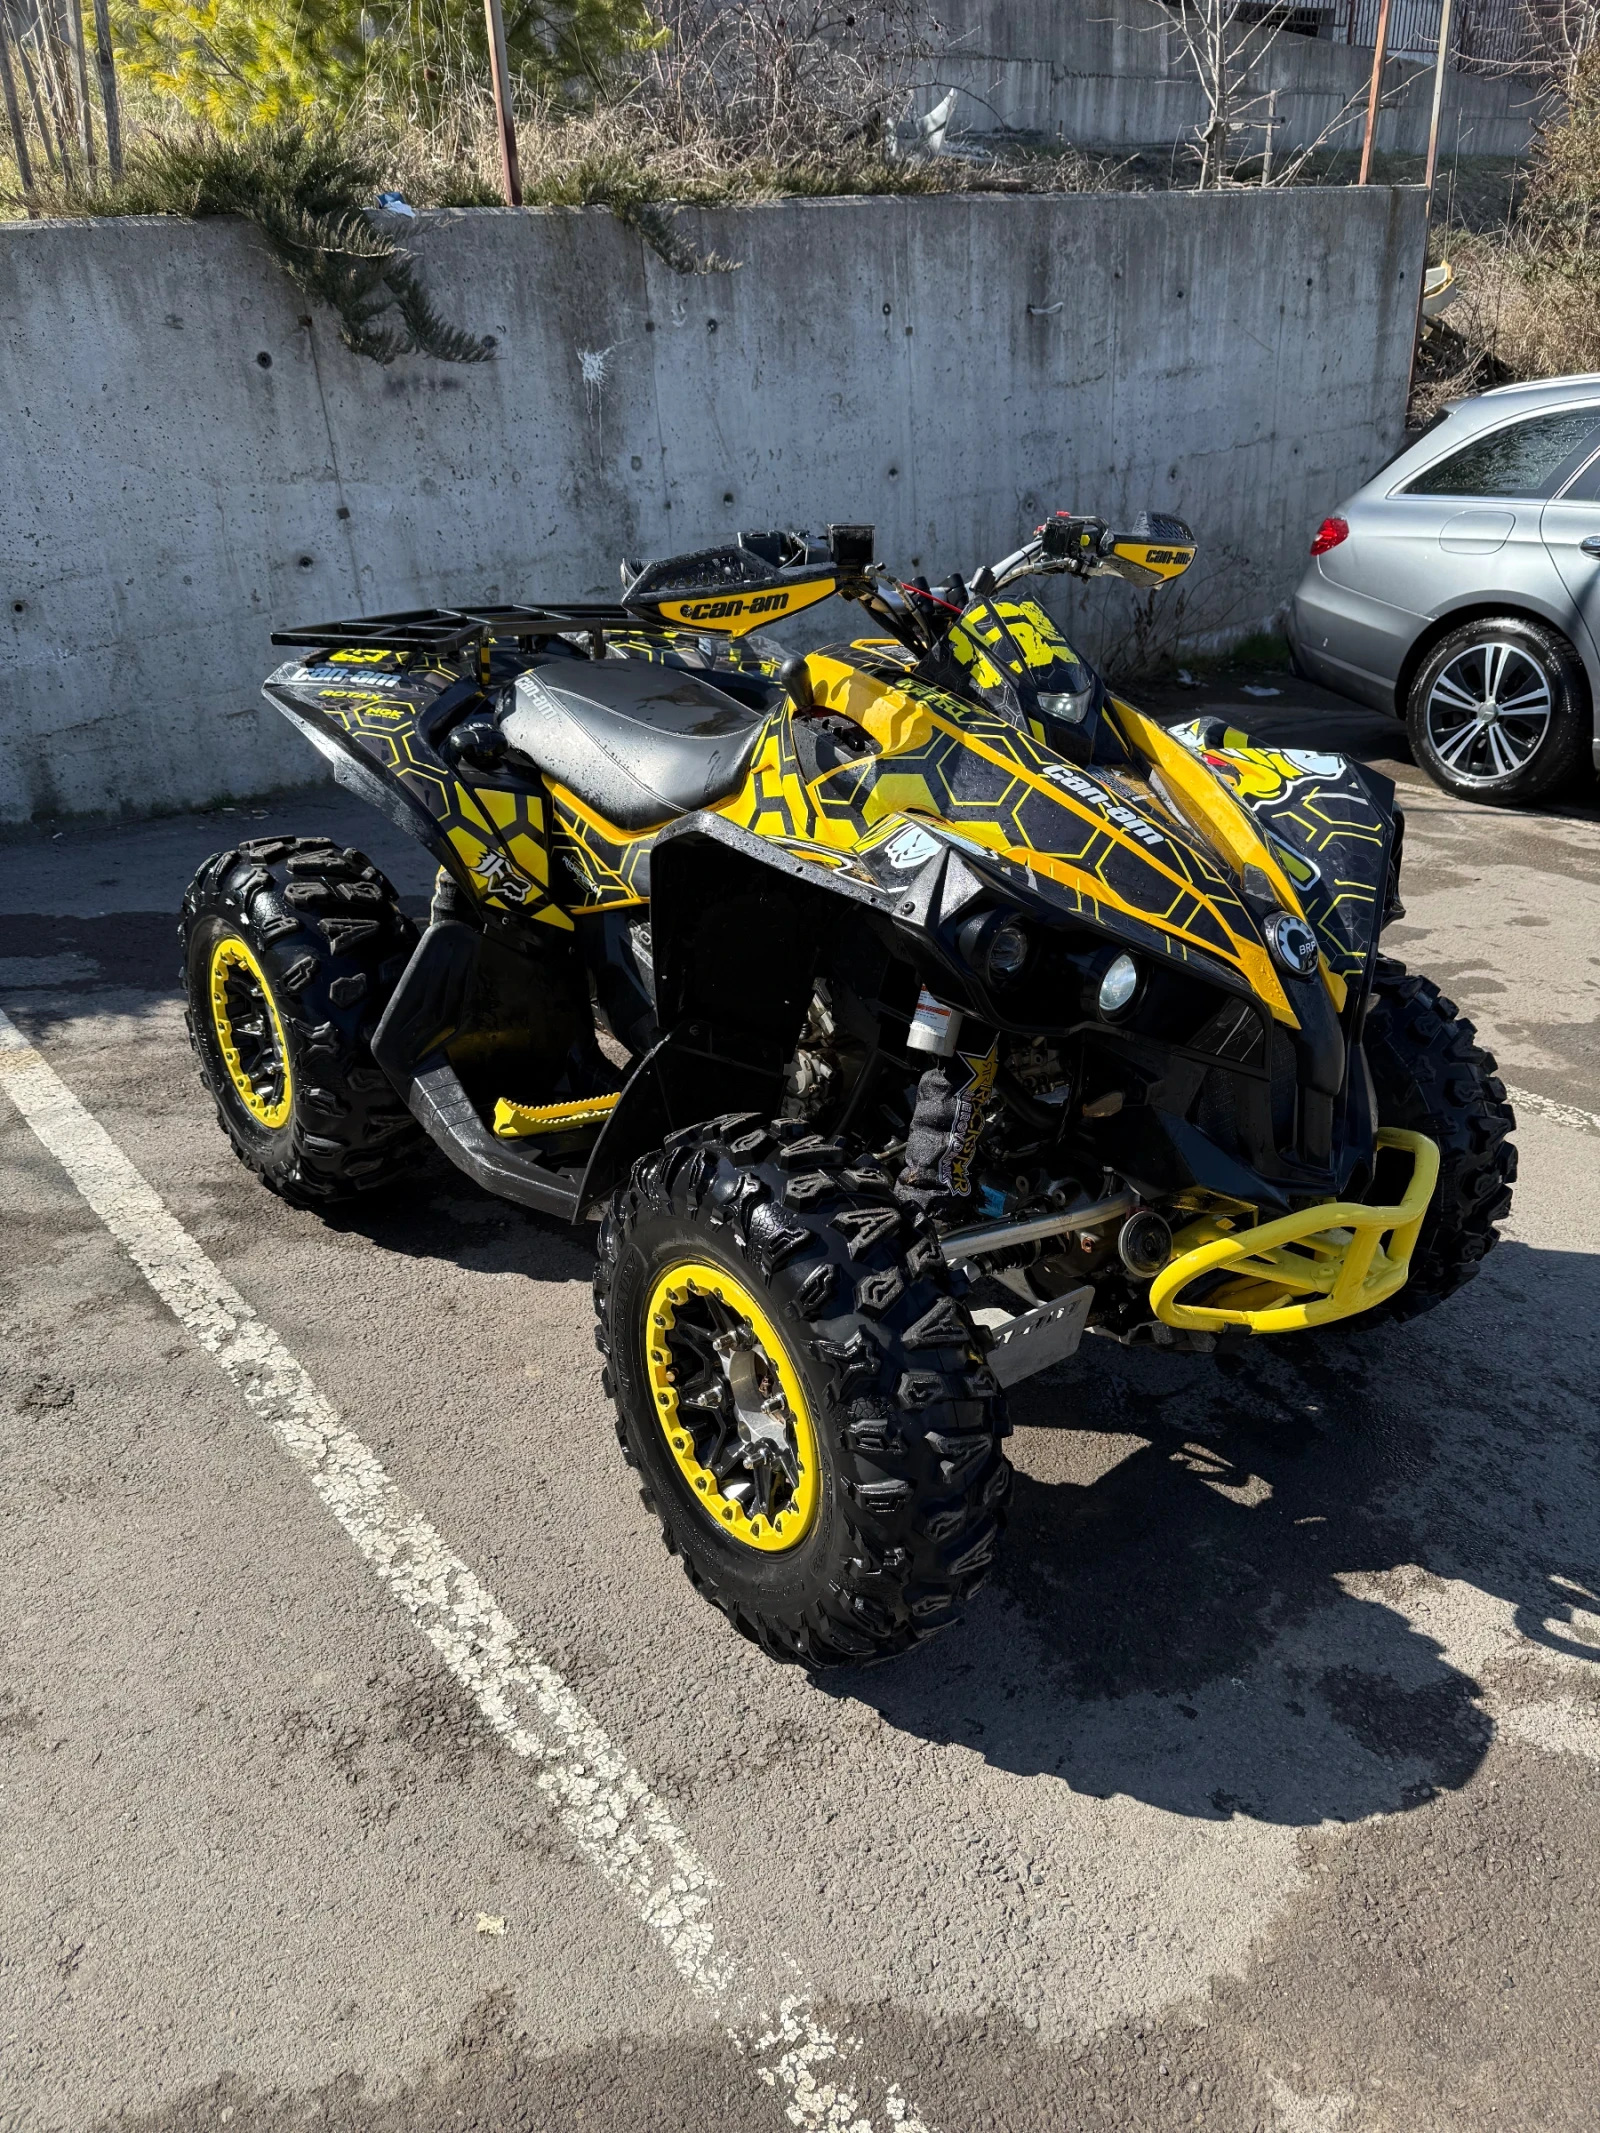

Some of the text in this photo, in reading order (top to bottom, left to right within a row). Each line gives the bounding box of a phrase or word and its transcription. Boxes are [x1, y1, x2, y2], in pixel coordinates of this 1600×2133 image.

[690, 592, 789, 620] can-am
[290, 667, 402, 687] can-am
[318, 690, 383, 700] ROTAX
[514, 676, 557, 720] can-am
[366, 707, 404, 718] NGK
[1042, 764, 1166, 845] can-am
[1299, 941, 1316, 955] BRP
